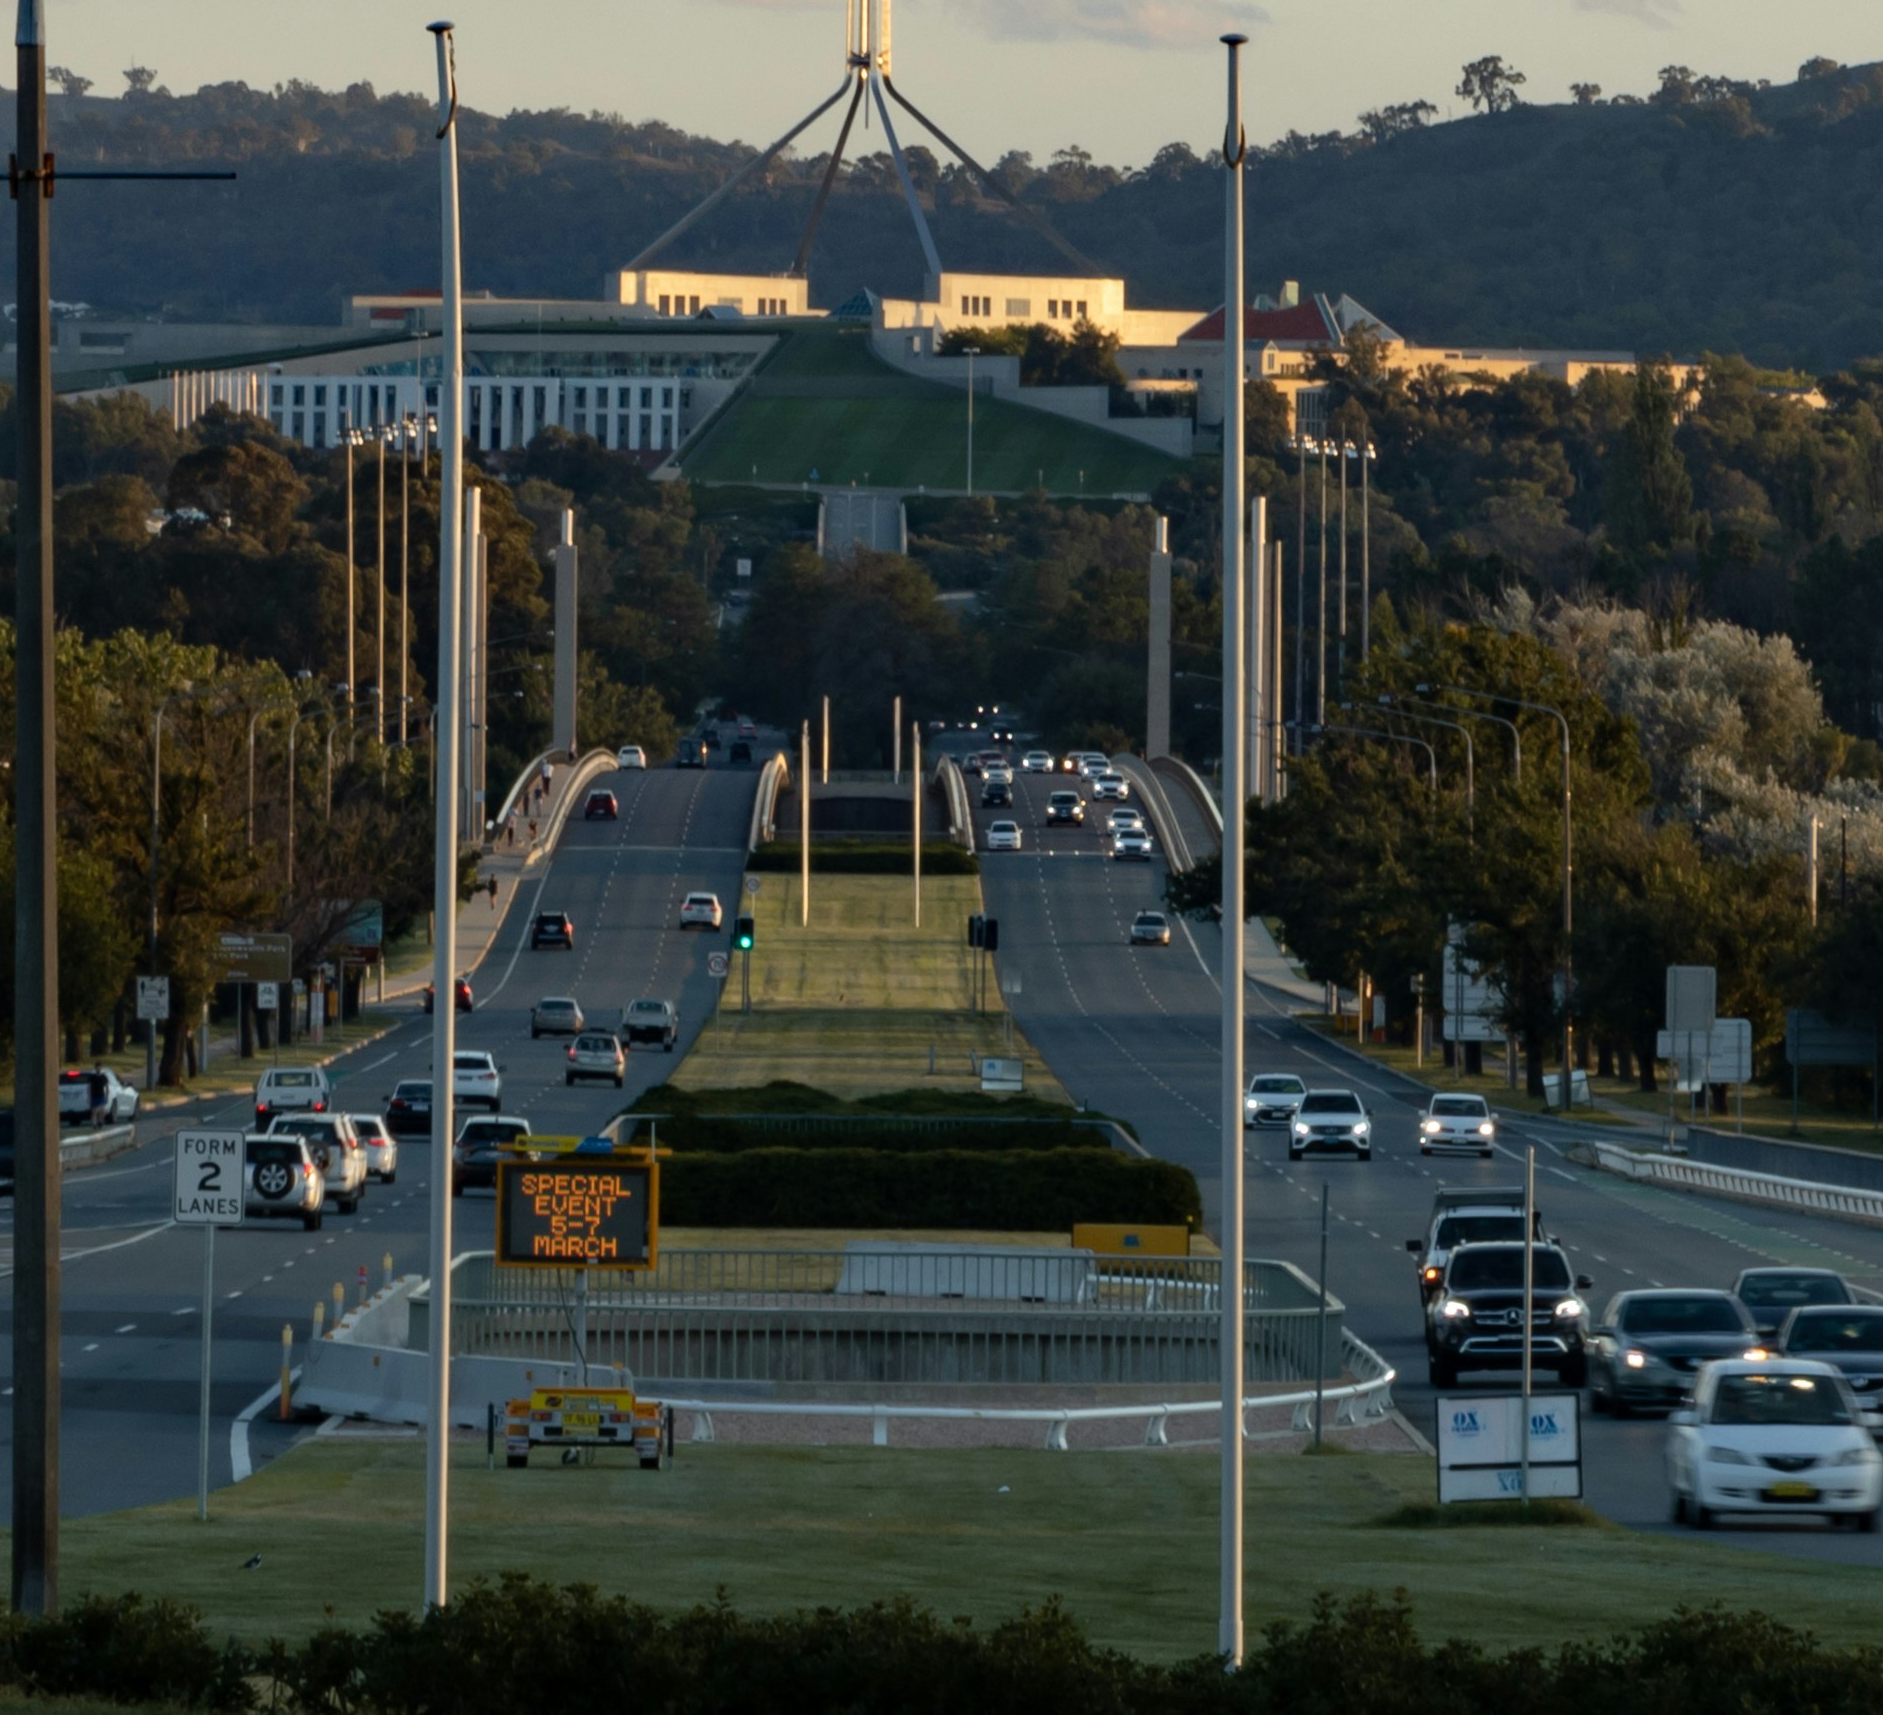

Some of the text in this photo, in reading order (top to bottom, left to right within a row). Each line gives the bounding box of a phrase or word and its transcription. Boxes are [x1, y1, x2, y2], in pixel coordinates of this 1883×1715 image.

[184, 1138, 236, 1155] FORM
[197, 1161, 221, 1191] 2
[521, 1173, 632, 1197] SPECIAL
[178, 1197, 239, 1215] LANES
[534, 1195, 617, 1217] EVENT
[551, 1215, 601, 1236] 5-7
[533, 1235, 617, 1258] MARCH
[1453, 1411, 1479, 1426] OX
[1531, 1413, 1557, 1429] OX
